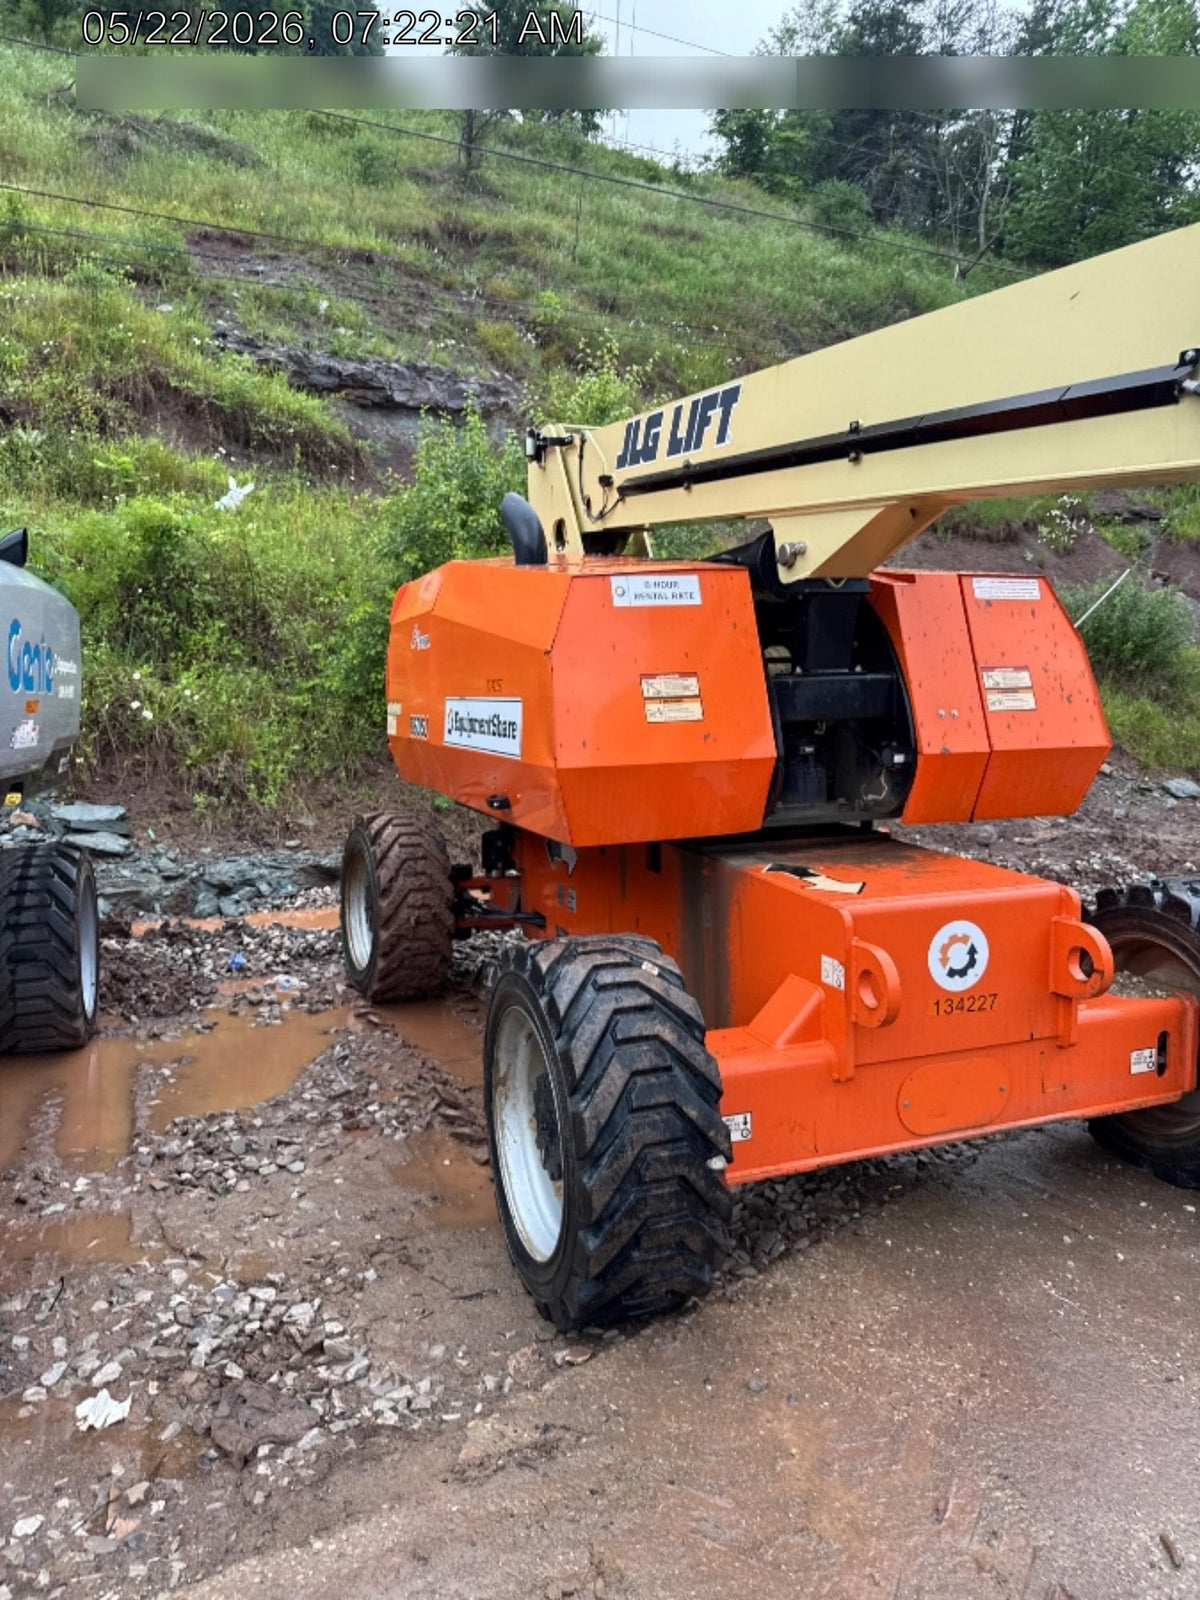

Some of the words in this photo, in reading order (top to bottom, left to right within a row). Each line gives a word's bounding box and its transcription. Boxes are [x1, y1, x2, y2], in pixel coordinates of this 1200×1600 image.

[615, 408, 664, 469] JLG
[665, 382, 743, 458] LIFT
[671, 591, 696, 600] RATE
[8, 617, 54, 695] Genie
[454, 710, 517, 740] EquipmentShare
[933, 993, 998, 1016] 134227
